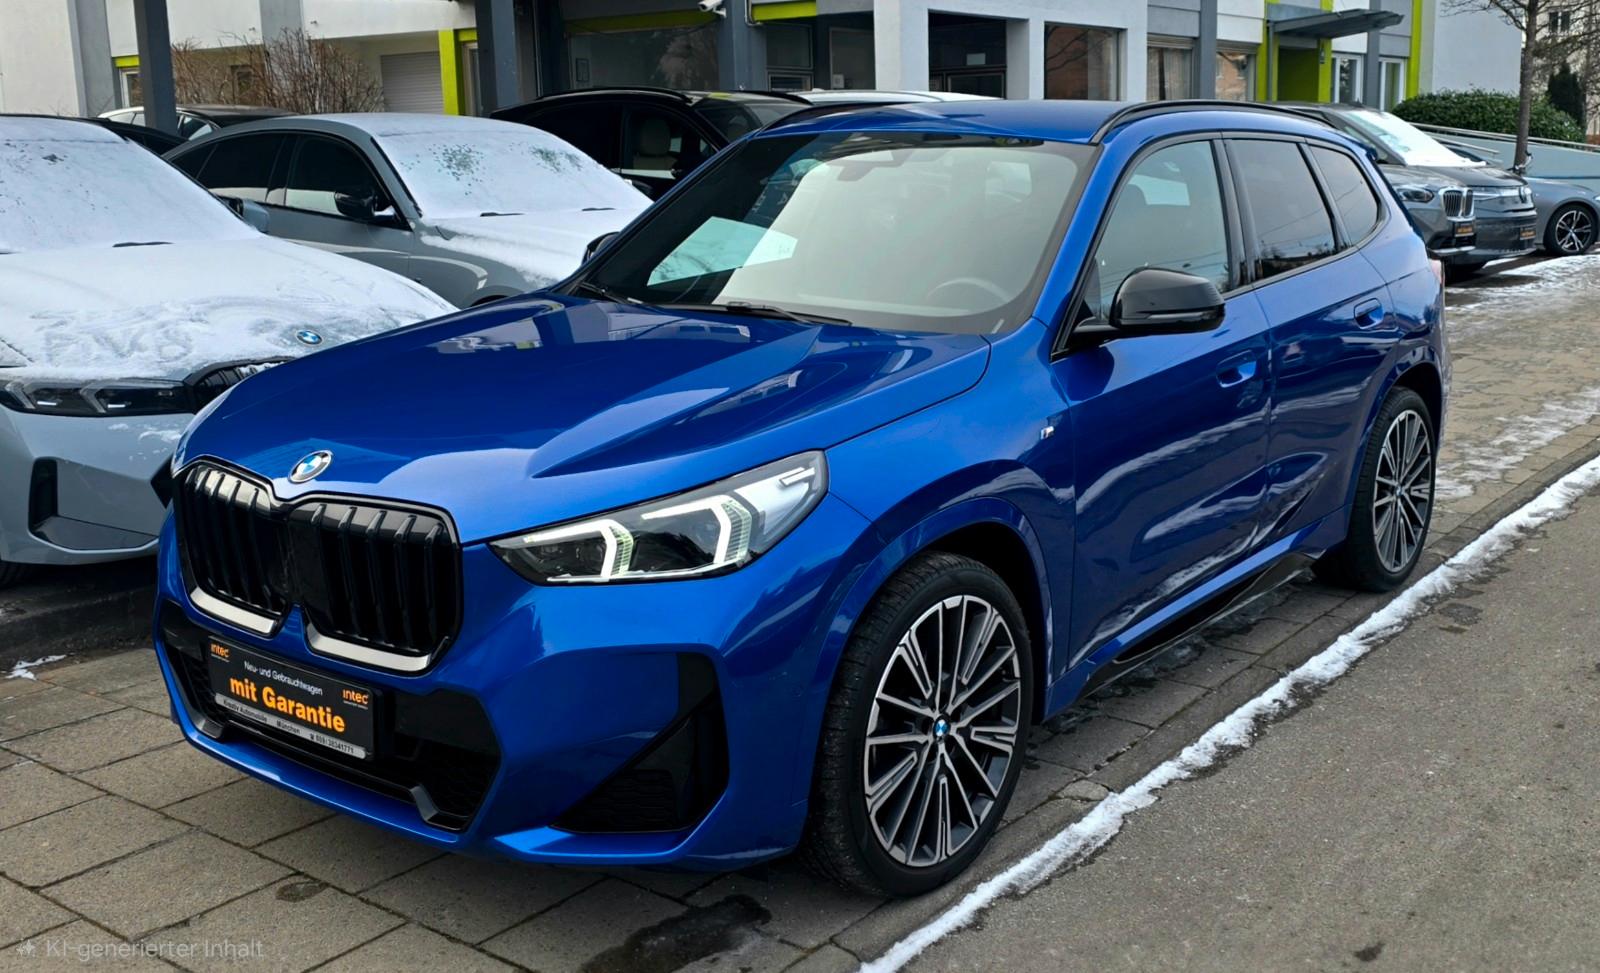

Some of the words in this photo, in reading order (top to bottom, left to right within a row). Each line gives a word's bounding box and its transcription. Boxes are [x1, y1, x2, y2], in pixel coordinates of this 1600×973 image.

[259, 667, 272, 679] und
[272, 670, 323, 697] Gebrauchtwagen
[229, 677, 258, 703] mit
[262, 686, 346, 734] Garantie
